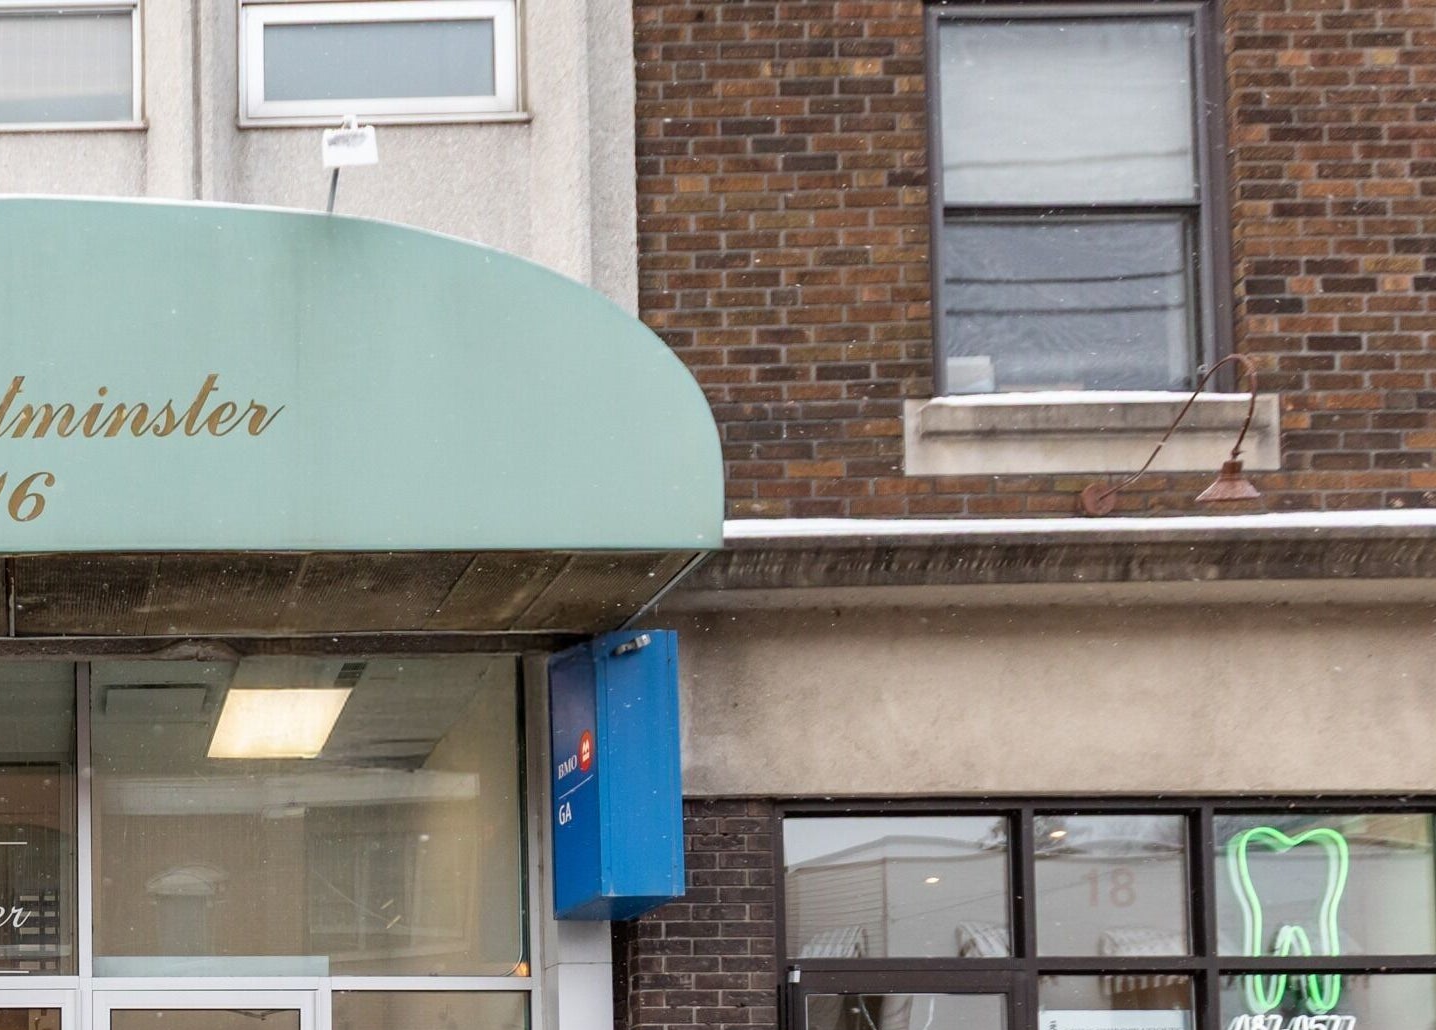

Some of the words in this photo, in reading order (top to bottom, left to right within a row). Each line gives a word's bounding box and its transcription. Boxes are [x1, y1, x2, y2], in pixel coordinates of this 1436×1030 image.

[558, 754, 578, 780] BMO
[558, 801, 572, 826] GA
[1083, 866, 1137, 908] 18
